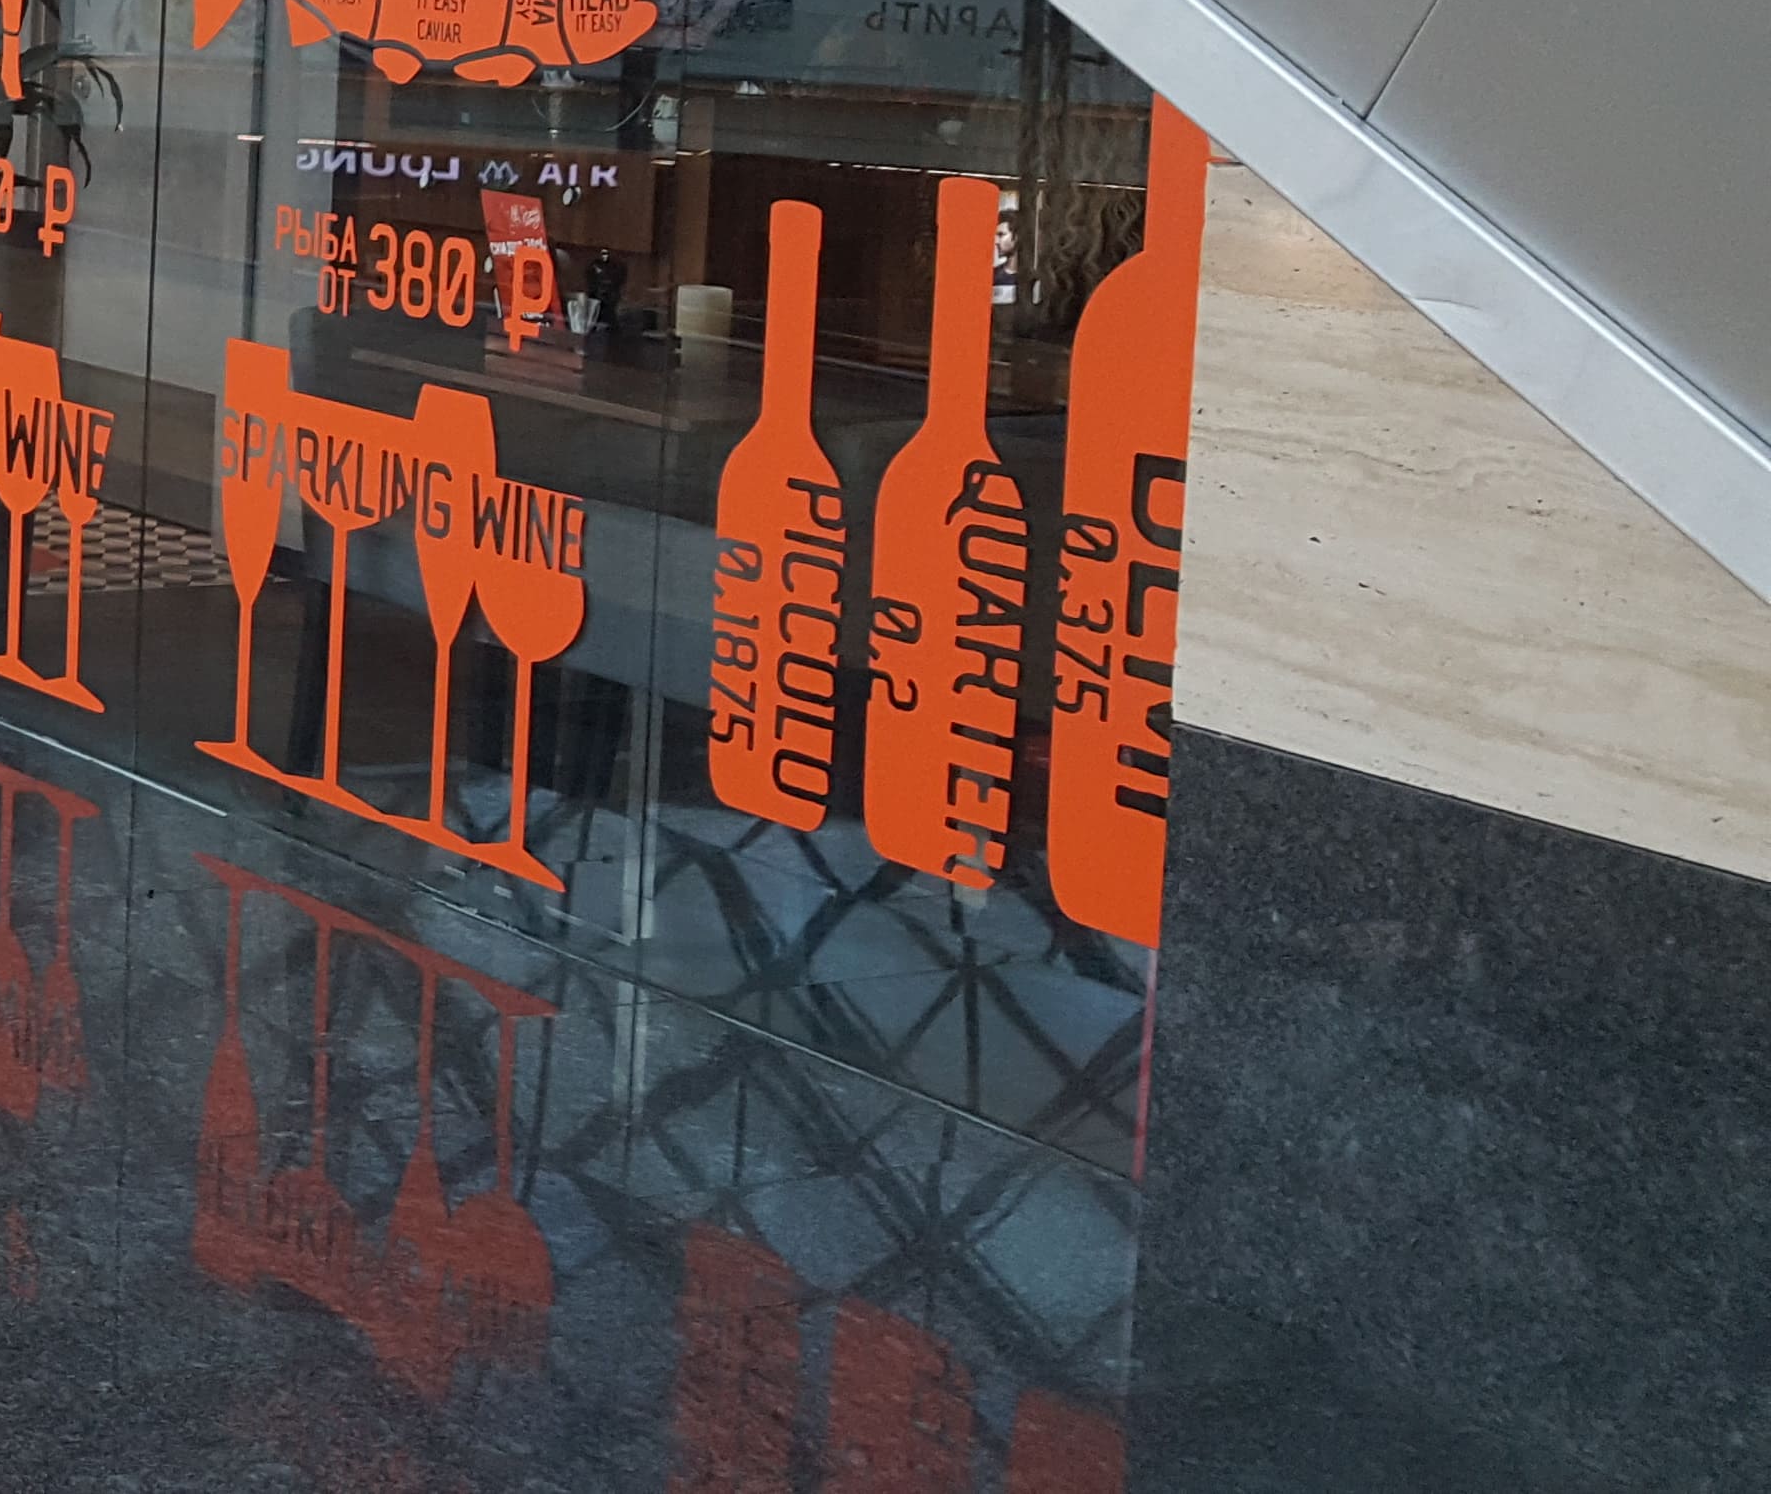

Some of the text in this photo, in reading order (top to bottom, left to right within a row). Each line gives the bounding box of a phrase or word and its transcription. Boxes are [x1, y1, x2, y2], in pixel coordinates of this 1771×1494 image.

[417, 18, 463, 44] CAVIAR
[575, 12, 624, 34] IT EASY
[275, 204, 358, 266] РЫБА
[367, 222, 476, 327] 380
[317, 264, 357, 318] ОТ
[3, 386, 115, 500] WINE
[219, 406, 586, 578] SPARKLING WINE
[771, 475, 850, 810] PICCOLO
